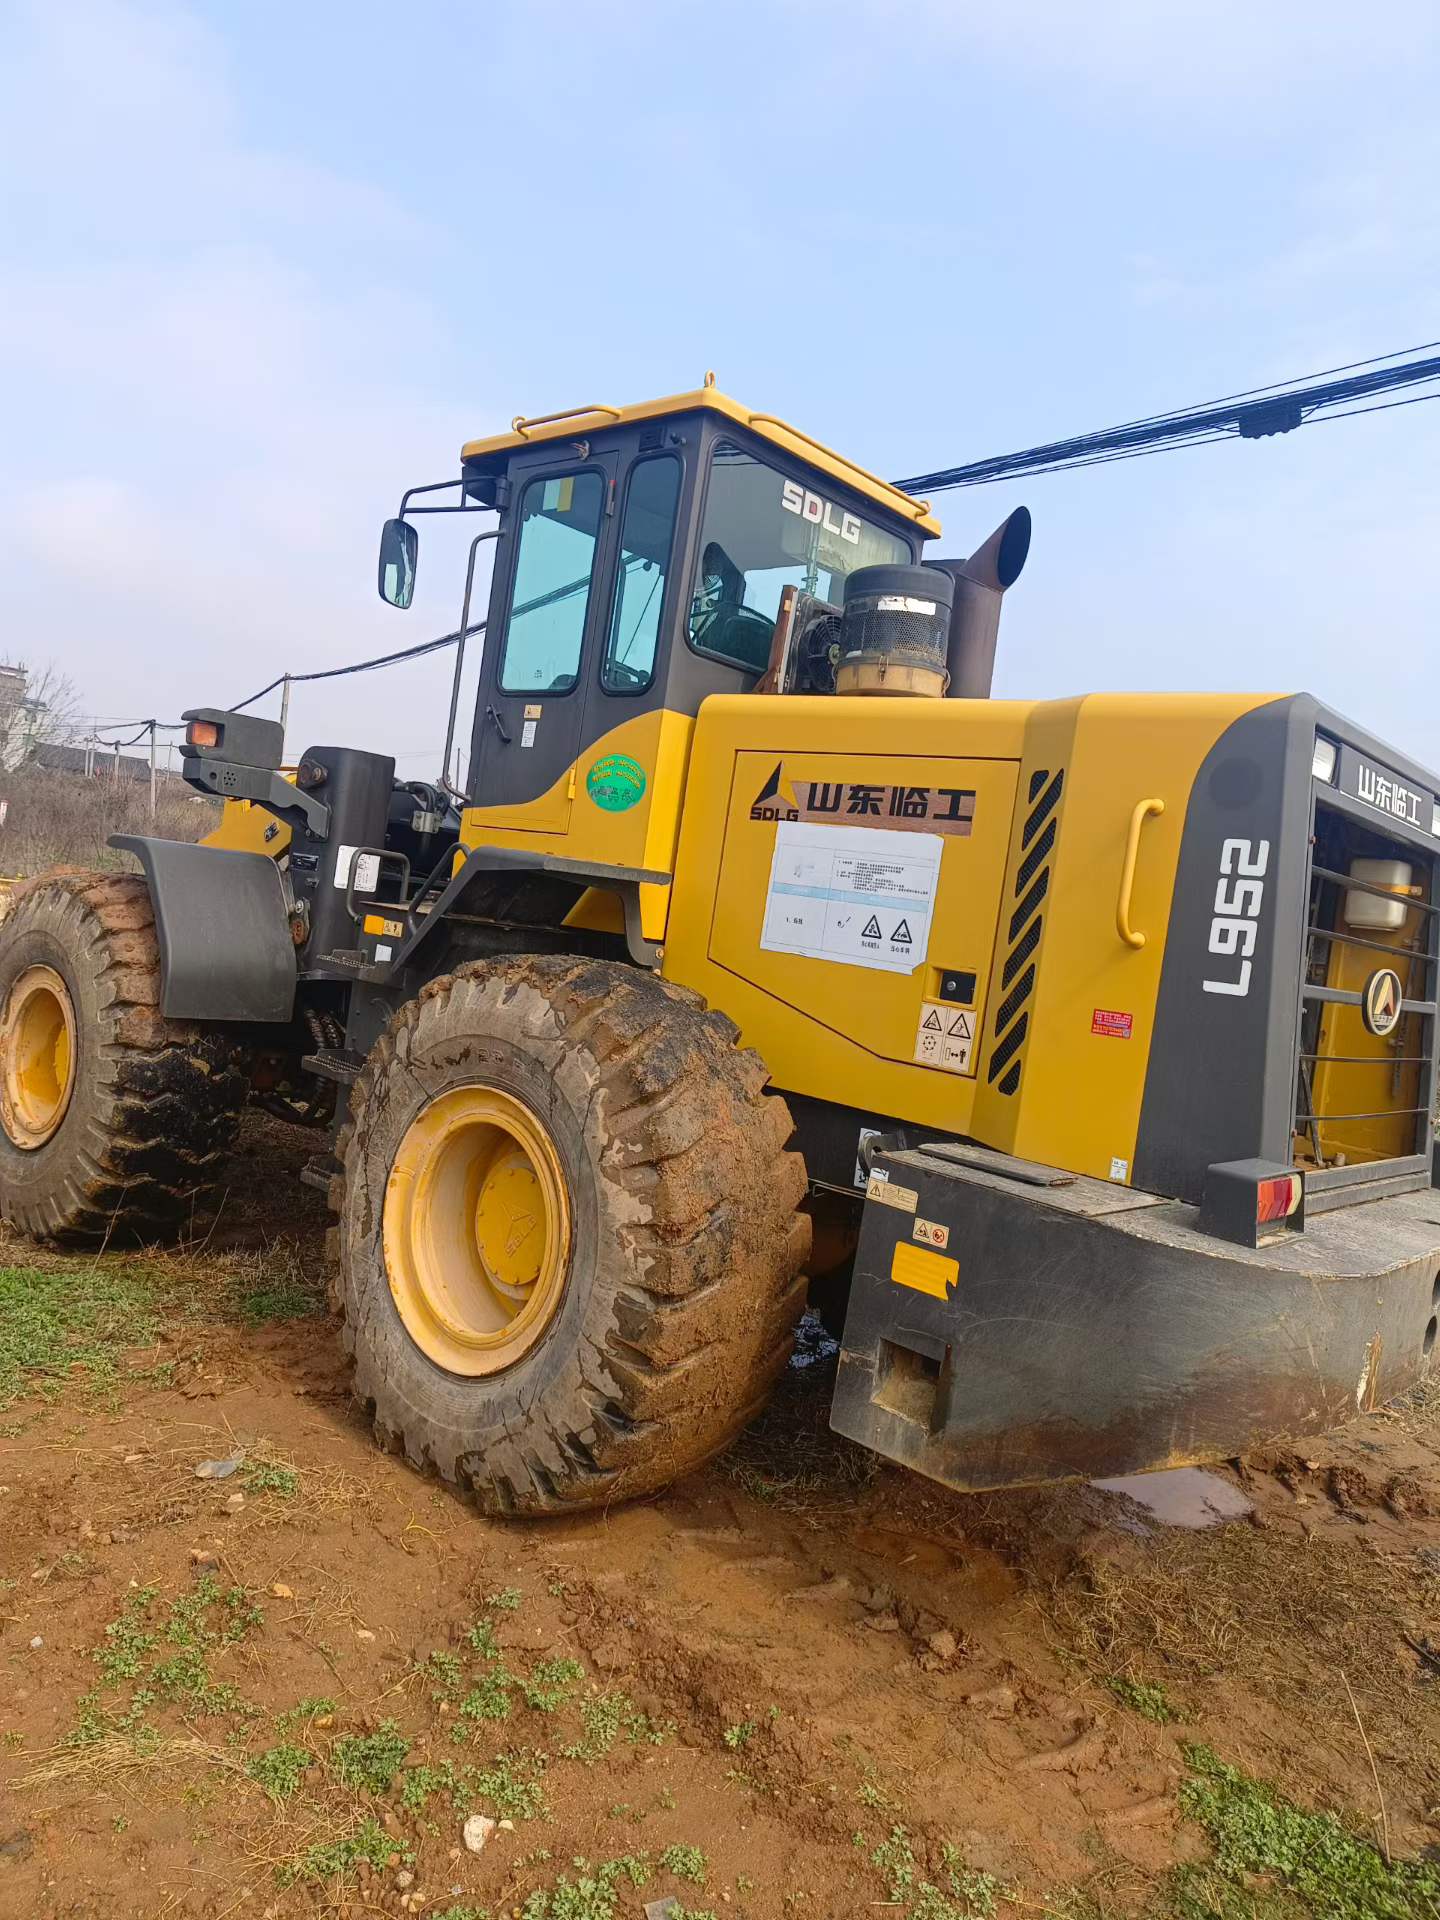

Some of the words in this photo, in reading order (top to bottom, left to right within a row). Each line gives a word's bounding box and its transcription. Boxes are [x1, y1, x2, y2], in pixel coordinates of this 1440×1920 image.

[781, 479, 862, 546] SDLG
[750, 807, 800, 822] SDLG
[806, 782, 976, 822] 山东临工
[1357, 764, 1422, 826] 山东临工
[1202, 838, 1270, 997] L952
